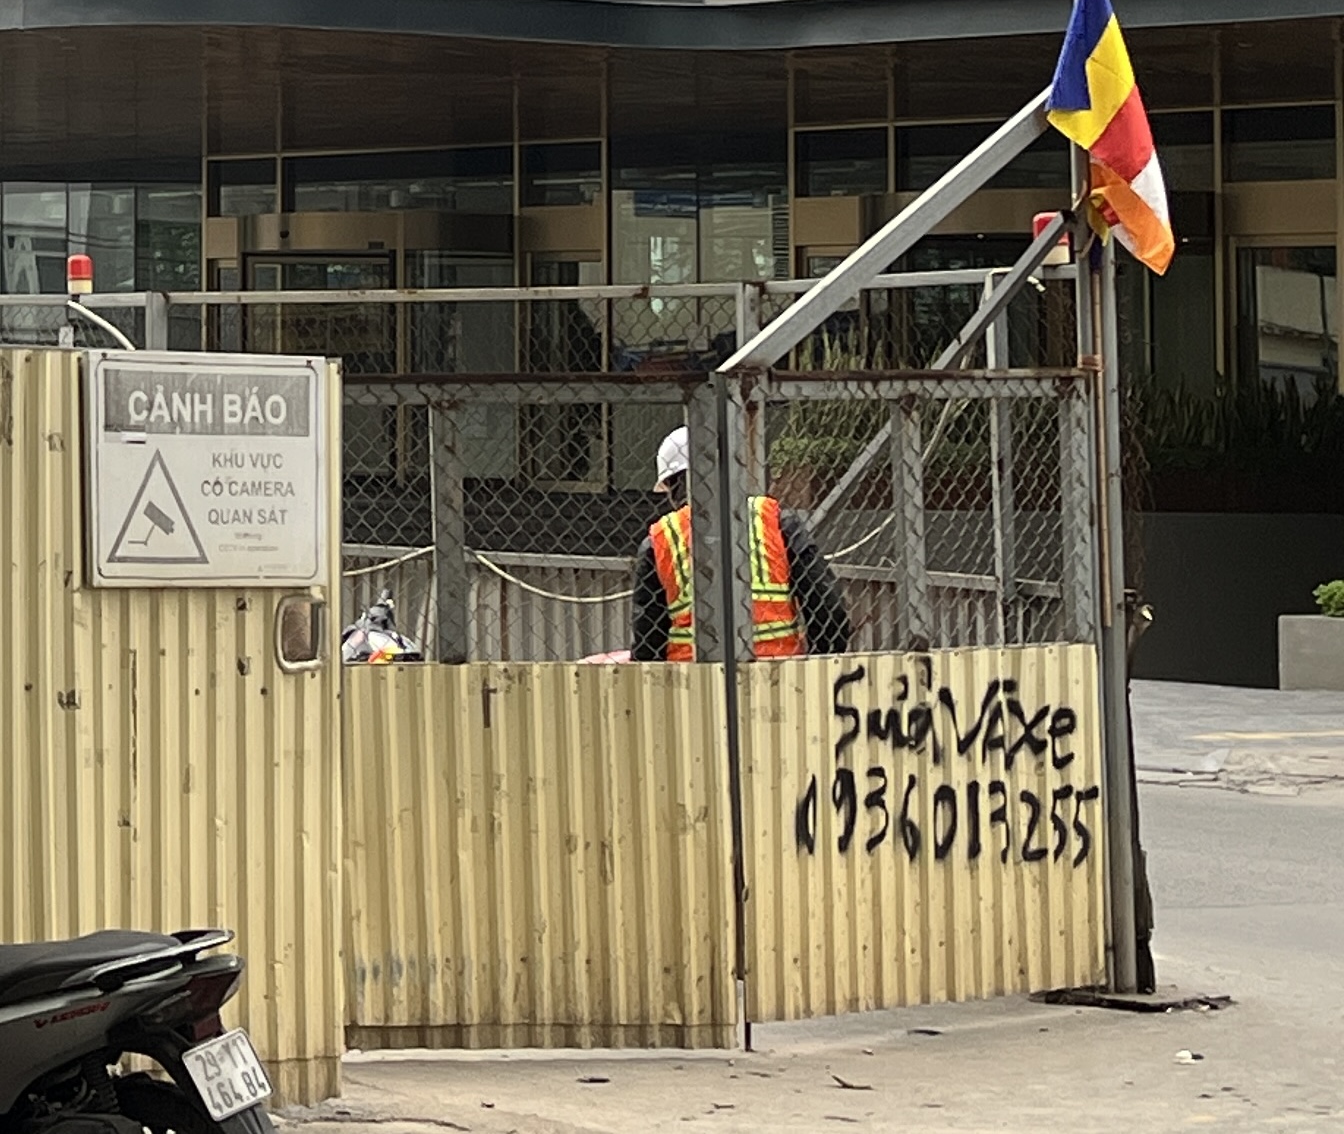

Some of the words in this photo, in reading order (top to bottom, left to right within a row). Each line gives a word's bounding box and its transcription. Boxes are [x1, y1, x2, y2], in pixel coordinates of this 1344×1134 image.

[128, 384, 212, 424] CẢNH
[223, 386, 287, 424] BÁO
[212, 452, 245, 469] KHU
[249, 453, 283, 472] VỰC
[201, 475, 224, 497] CÓ
[228, 480, 295, 498] CAMERA
[208, 508, 252, 526] QUAN
[257, 505, 288, 525] SÁT
[795, 767, 1100, 869] 0936013255
